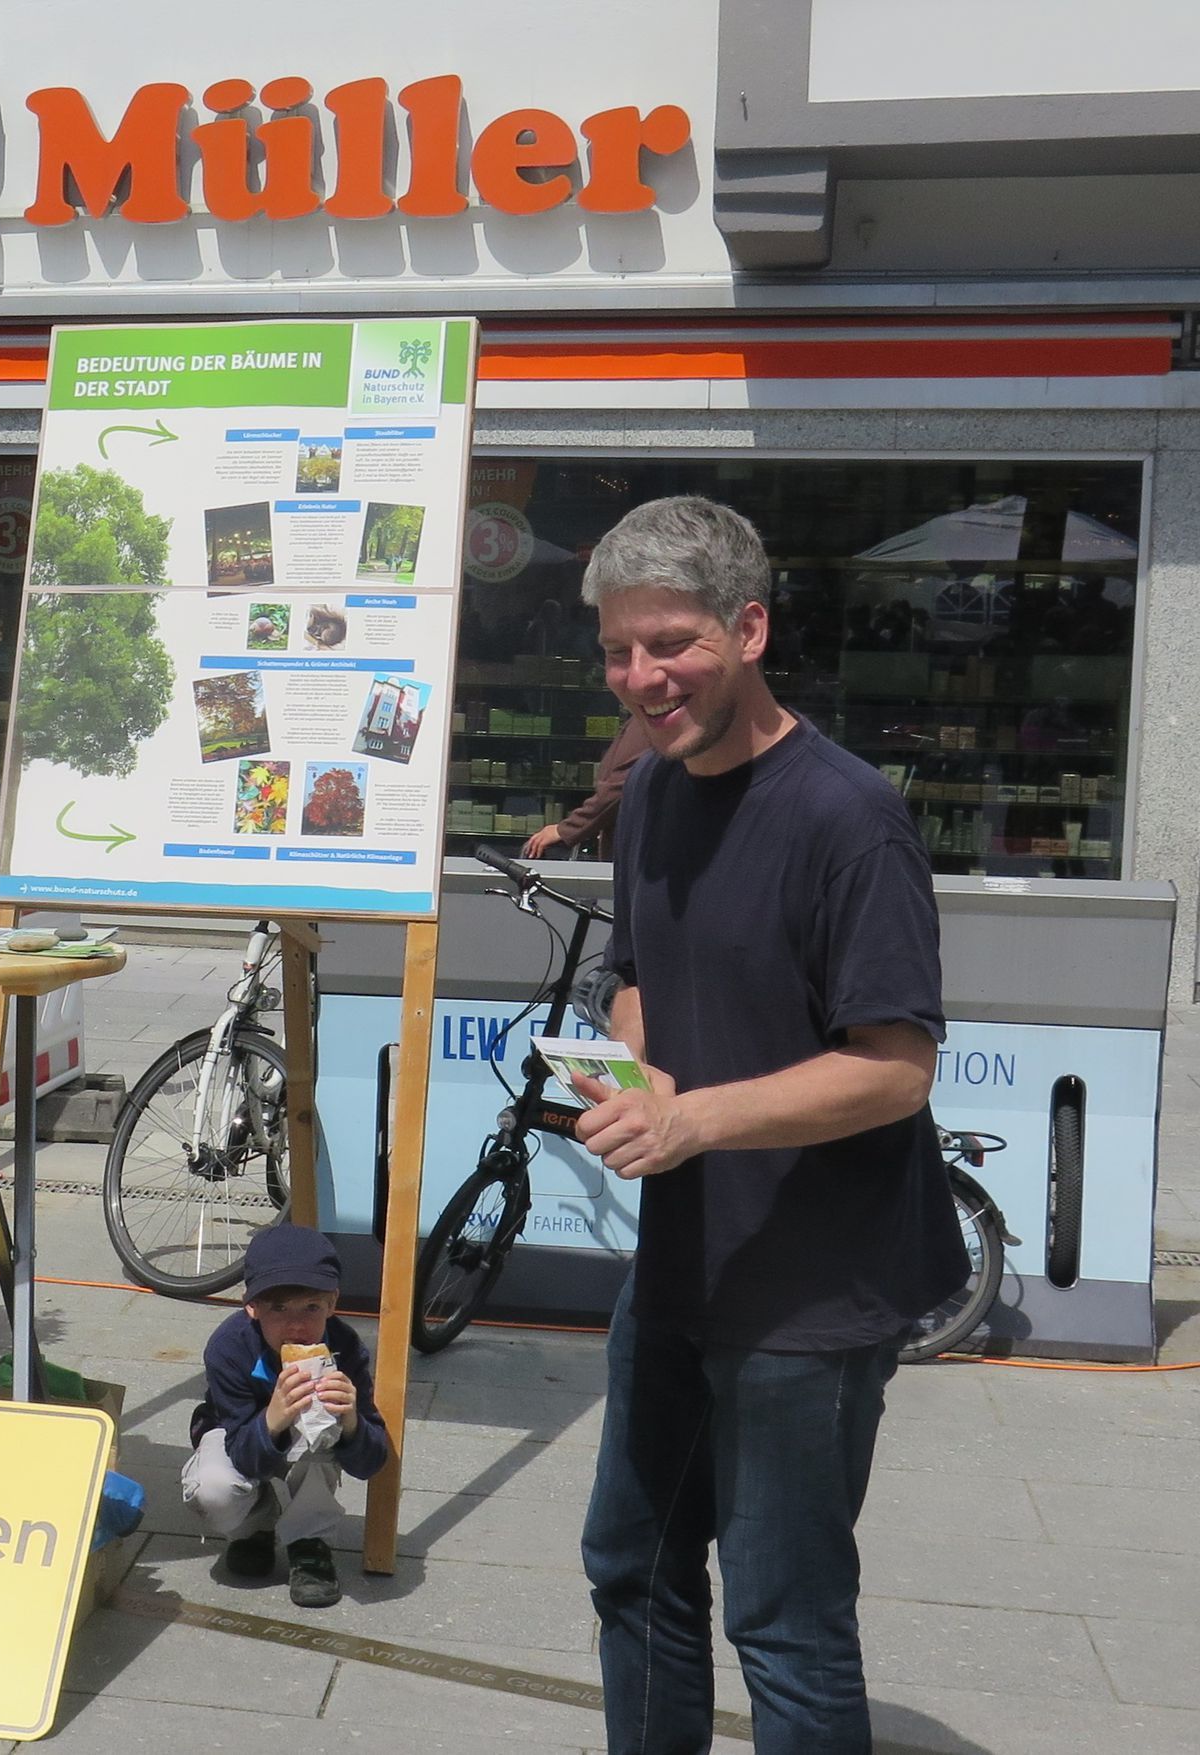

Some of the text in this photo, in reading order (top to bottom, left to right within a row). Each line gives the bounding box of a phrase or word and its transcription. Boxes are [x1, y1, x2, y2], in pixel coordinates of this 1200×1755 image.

[25, 74, 691, 227] Müller
[77, 349, 322, 375] BEDEUTUNG DER BÄUME IN
[364, 369, 400, 380] BUND
[74, 378, 171, 398] DER STADT
[363, 381, 425, 393] Naturschutz
[362, 393, 425, 406] in Bayern e.V.
[472, 468, 517, 481] MEHR
[31, 885, 138, 897] www.bund-naturschutz.de
[442, 1015, 510, 1062] LEW
[936, 1050, 1016, 1087] TION
[533, 1215, 594, 1234] FAHREN
[263, 1624, 311, 1641] Für
[311, 1634, 350, 1650] die
[355, 1645, 446, 1670] Anfuhr
[449, 1664, 498, 1682] des
[505, 1676, 603, 1705] Getreid
